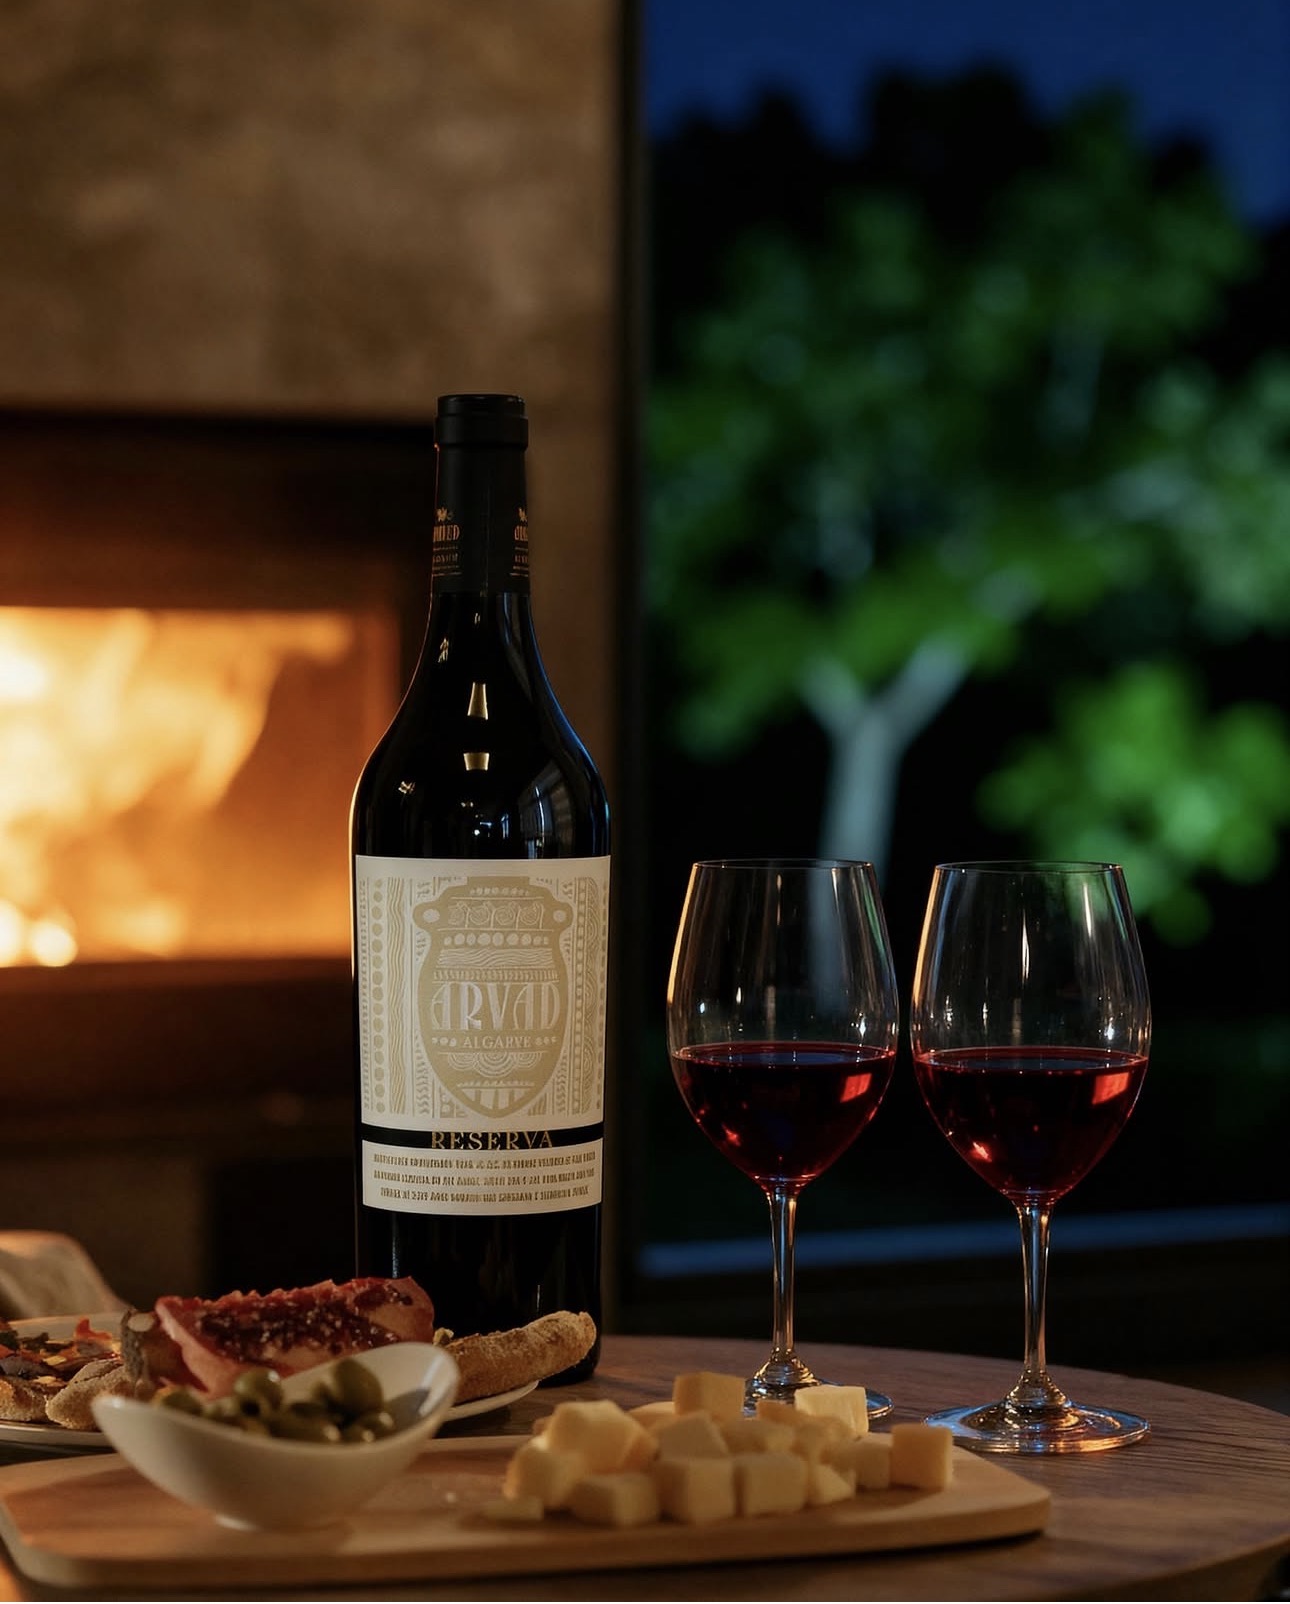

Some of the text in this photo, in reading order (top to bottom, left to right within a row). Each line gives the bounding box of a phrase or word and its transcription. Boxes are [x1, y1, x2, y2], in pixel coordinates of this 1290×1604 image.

[431, 981, 561, 1031] ARVAD
[462, 1035, 532, 1049] ALGARVE
[431, 1130, 553, 1150] RESERVA
